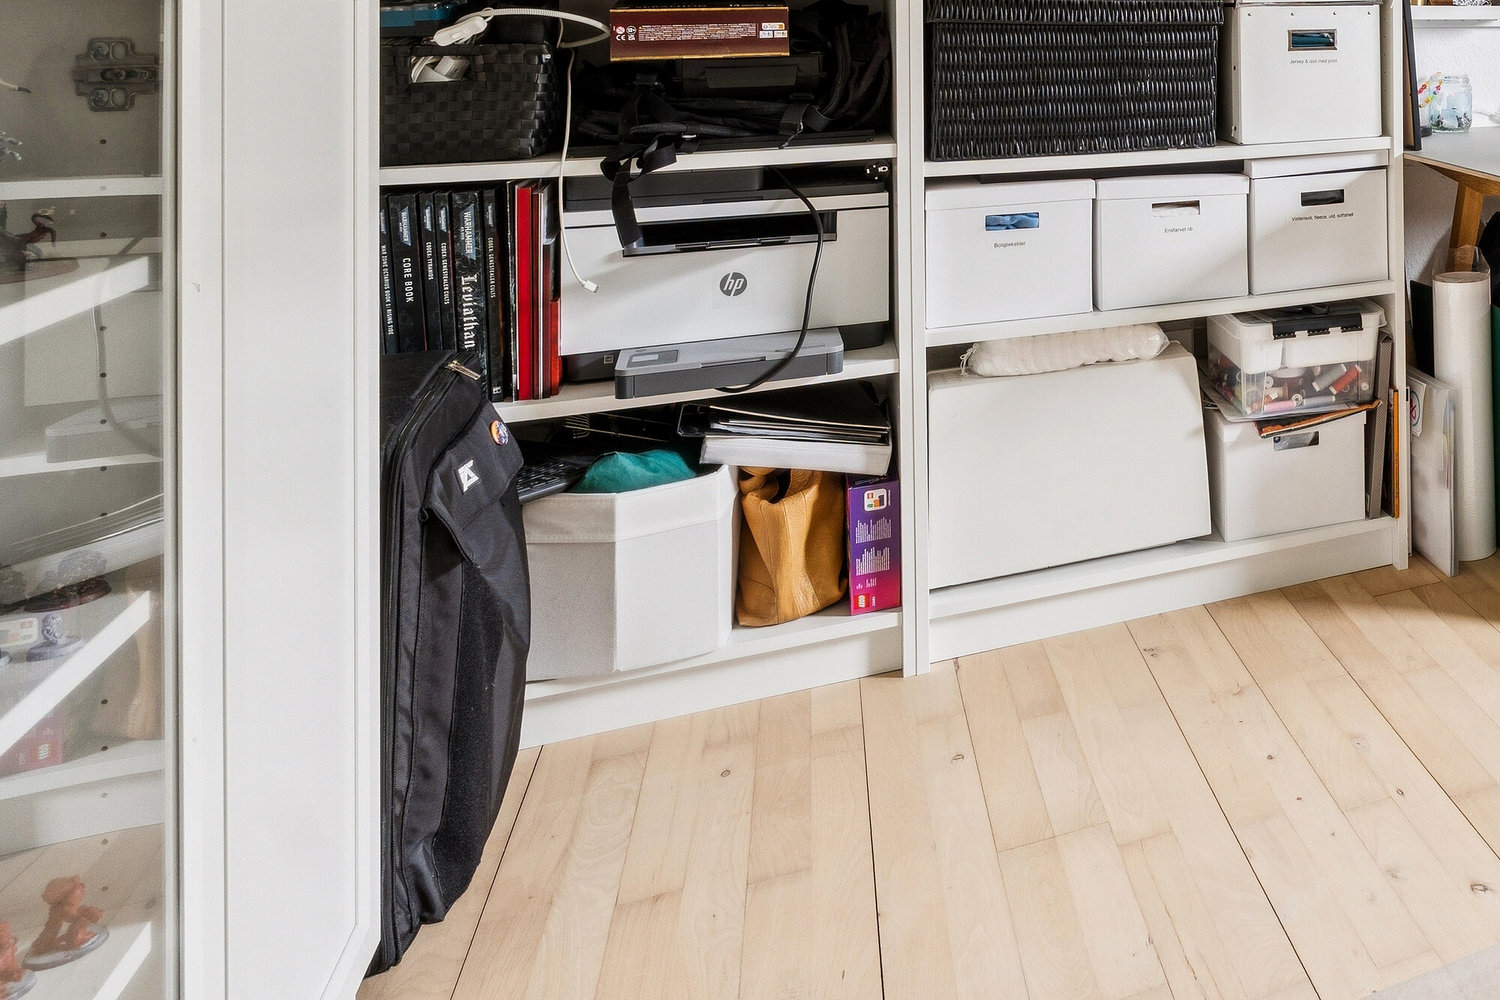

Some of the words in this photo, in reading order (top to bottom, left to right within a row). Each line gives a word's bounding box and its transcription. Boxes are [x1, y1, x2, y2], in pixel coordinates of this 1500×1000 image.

[464, 212, 472, 253] WARHAMMER
[993, 241, 1026, 249] Boligtekstiler
[403, 258, 412, 278] CORE
[405, 282, 413, 302] BOOK
[722, 271, 745, 296] hp
[461, 274, 479, 348] Leviathan
